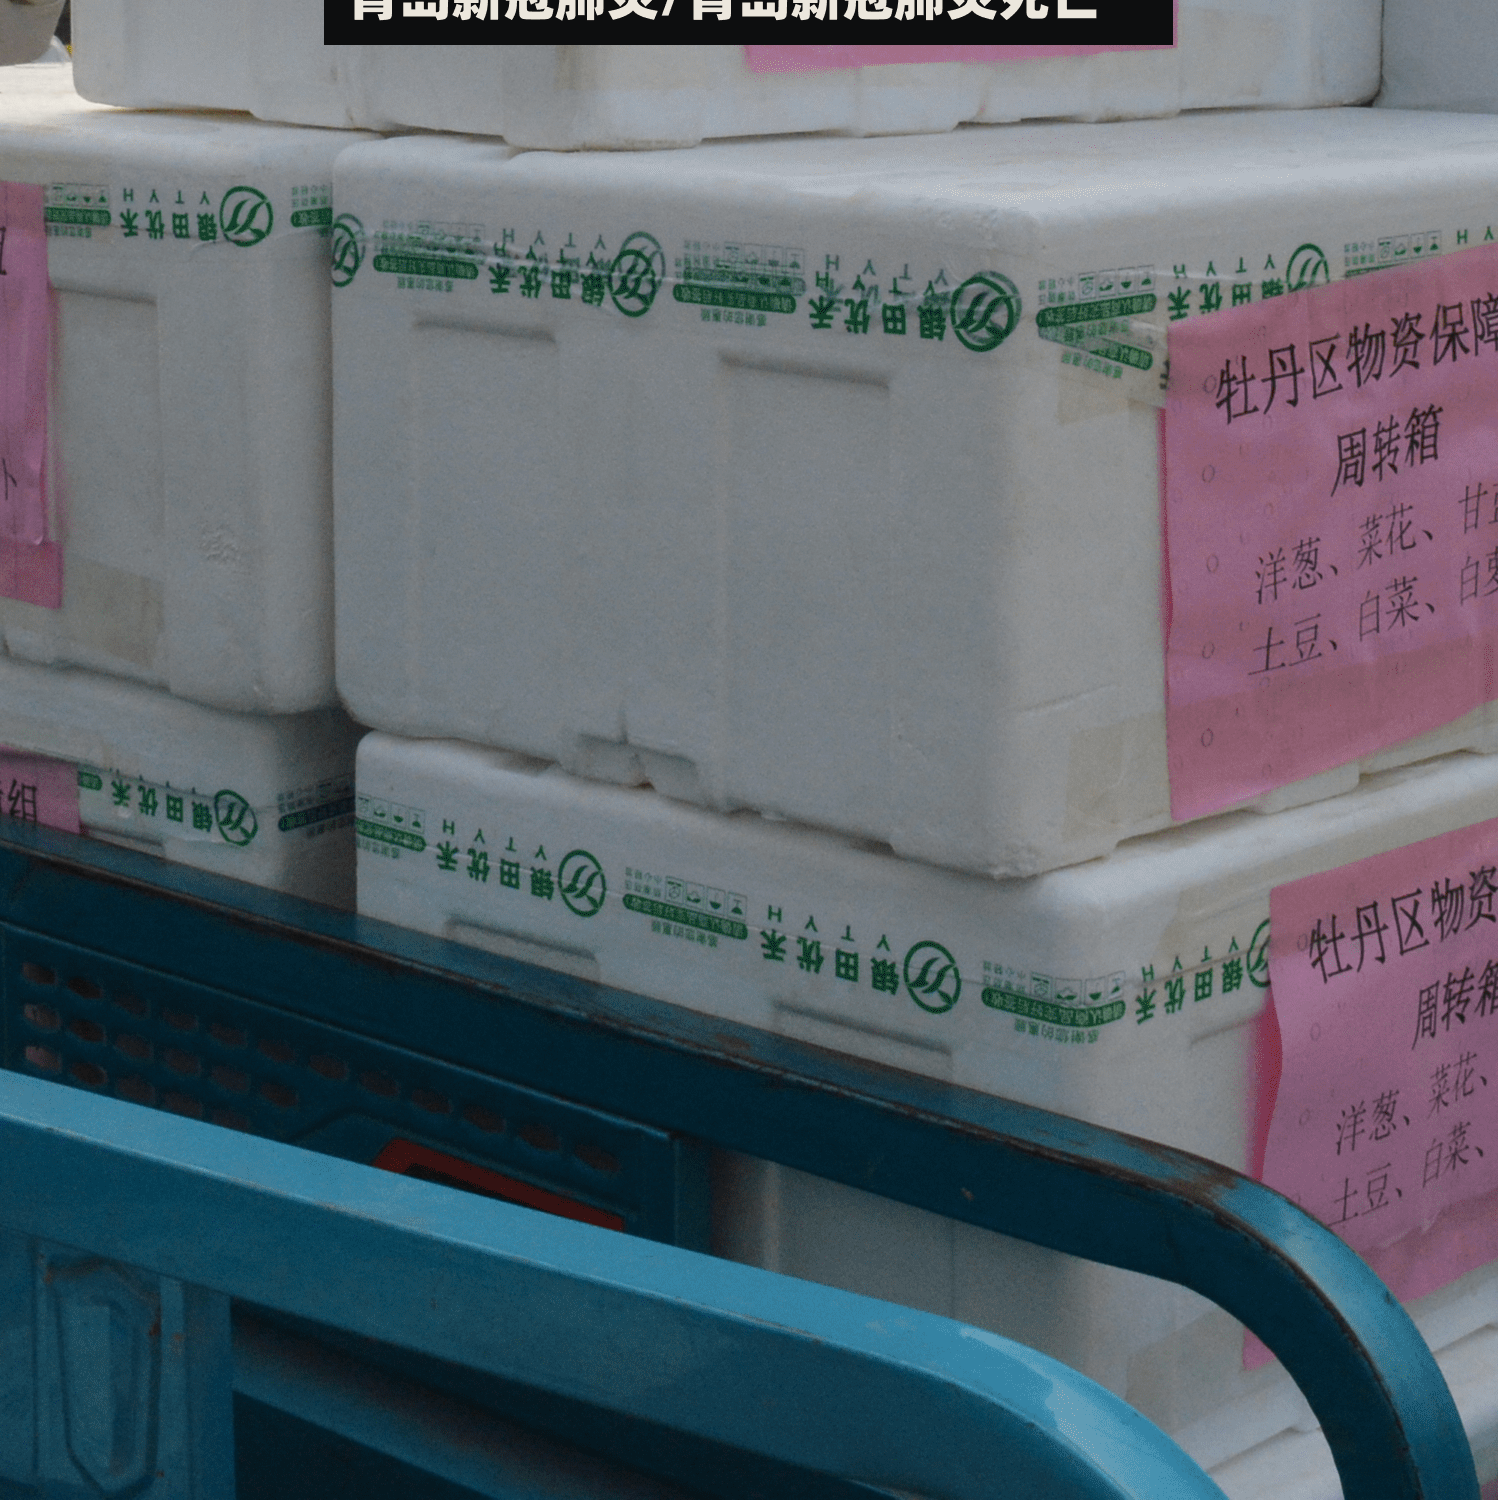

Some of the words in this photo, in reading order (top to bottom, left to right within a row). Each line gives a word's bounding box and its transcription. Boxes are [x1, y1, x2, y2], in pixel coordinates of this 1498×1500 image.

[120, 208, 217, 241] 银田优禾
[1330, 403, 1444, 497] 周转箱
[110, 780, 212, 832] 银田优禾
[436, 840, 554, 900] 银田优禾
[760, 928, 900, 995] 银田优禾
[1135, 957, 1243, 1025] 银田优禾
